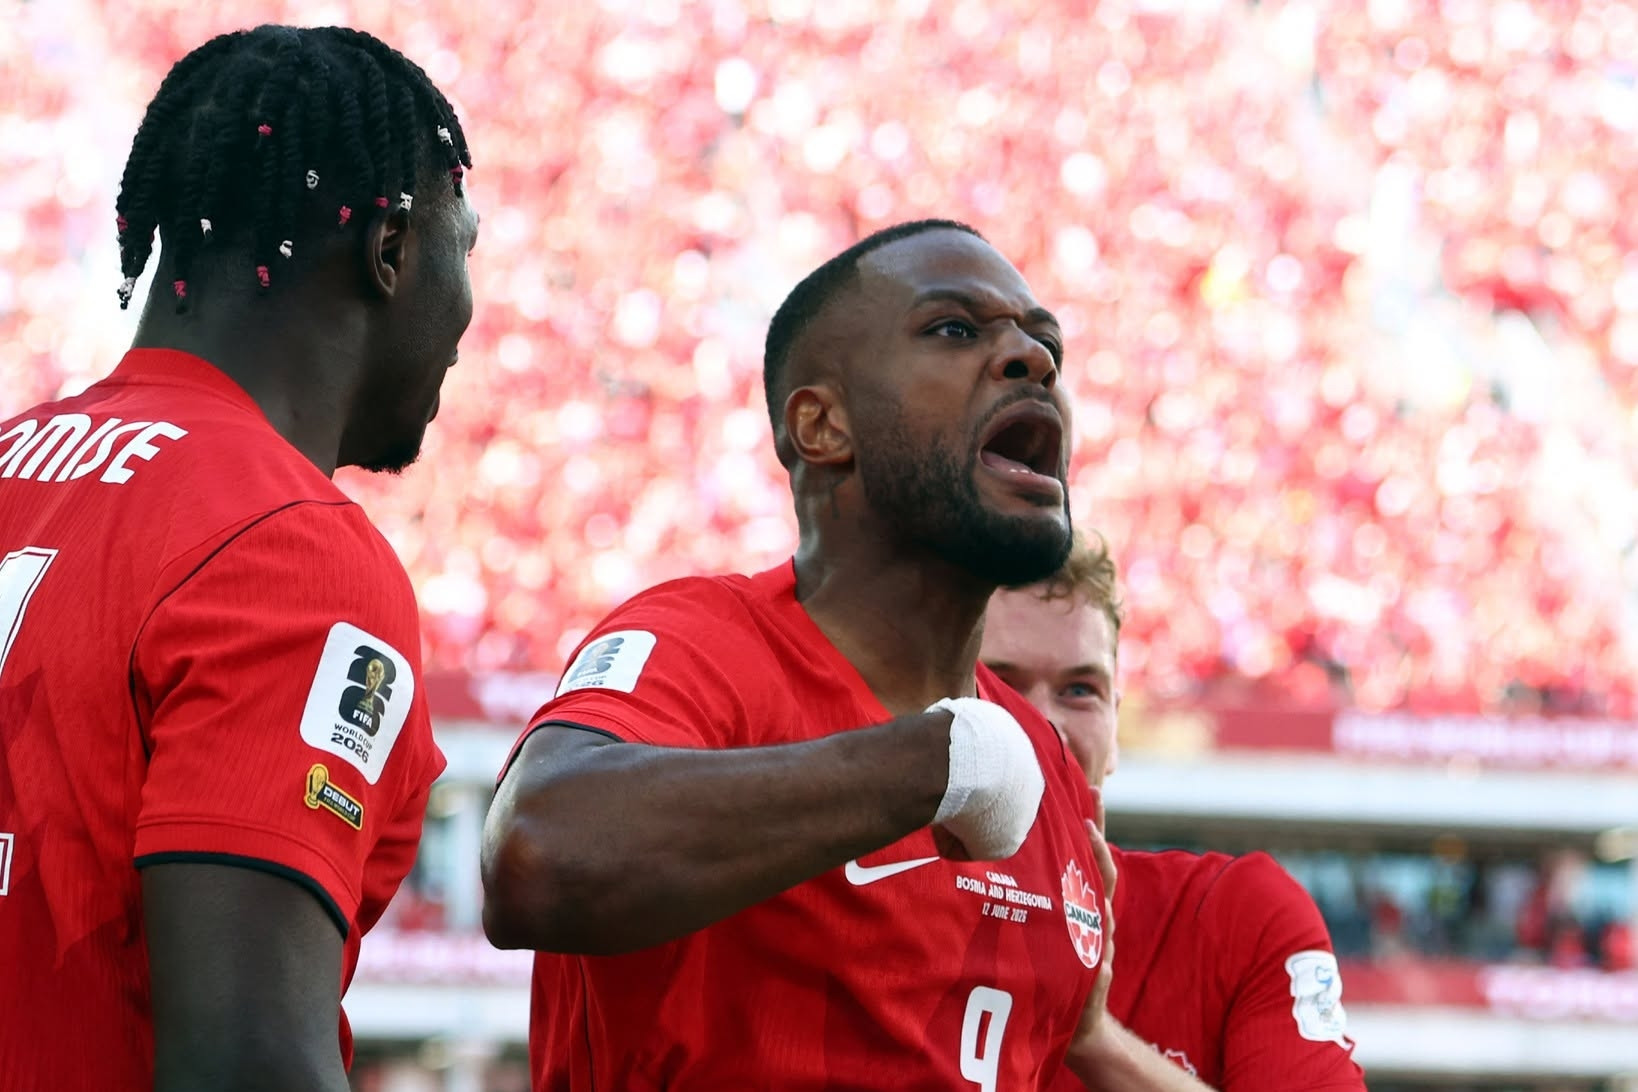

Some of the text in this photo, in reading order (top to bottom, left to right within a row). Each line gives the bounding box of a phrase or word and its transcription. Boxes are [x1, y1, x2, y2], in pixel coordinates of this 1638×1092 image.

[352, 709, 373, 729] FIFA
[330, 732, 369, 764] 2026
[334, 723, 373, 751] WORLD CUP
[323, 785, 360, 816] DEBUT
[956, 875, 1053, 911] BOSNIA AND HERZEGOVINA
[982, 902, 991, 916] 12
[990, 904, 1010, 920] JUNE
[1065, 903, 1101, 931] CANADA
[960, 986, 1013, 1092] 9
